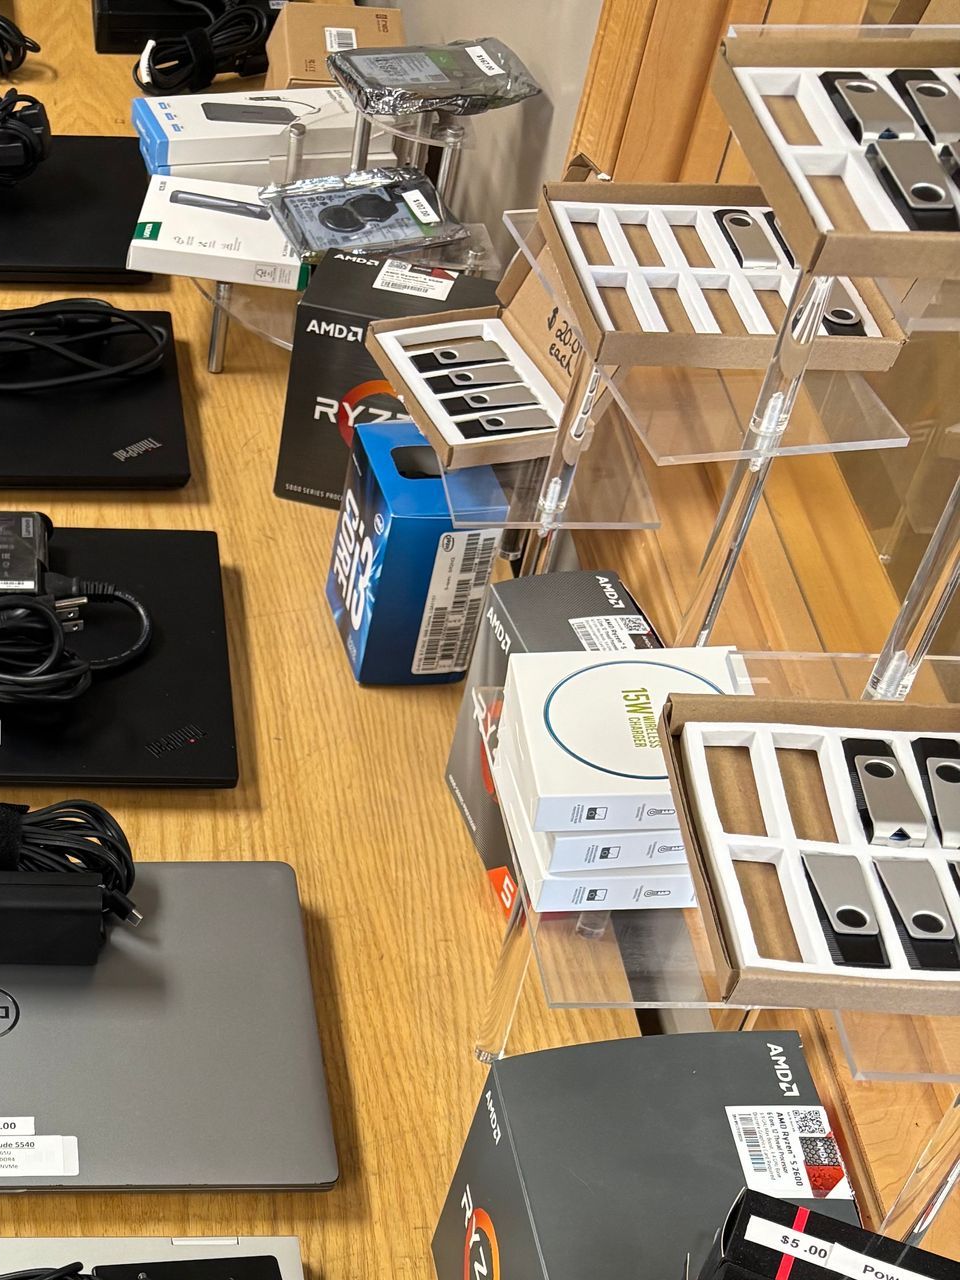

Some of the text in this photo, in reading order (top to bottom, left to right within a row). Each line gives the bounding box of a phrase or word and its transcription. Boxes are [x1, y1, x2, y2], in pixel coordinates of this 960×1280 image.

[306, 320, 348, 338] AMD
[549, 343, 572, 377] each
[313, 396, 411, 428] RYZ
[112, 438, 162, 462] ThinkPad
[303, 486, 324, 498] SERIES
[334, 488, 360, 600] CORE
[345, 520, 374, 631] i3
[622, 688, 653, 714] 15W
[628, 717, 647, 748] CHARGER
[642, 715, 659, 748] WIRELESS
[500, 874, 514, 909] 5
[766, 1042, 793, 1082] AMD
[15, 1141, 35, 1149] 5540
[776, 1111, 787, 1130] AMD
[792, 1166, 803, 1186] 2600
